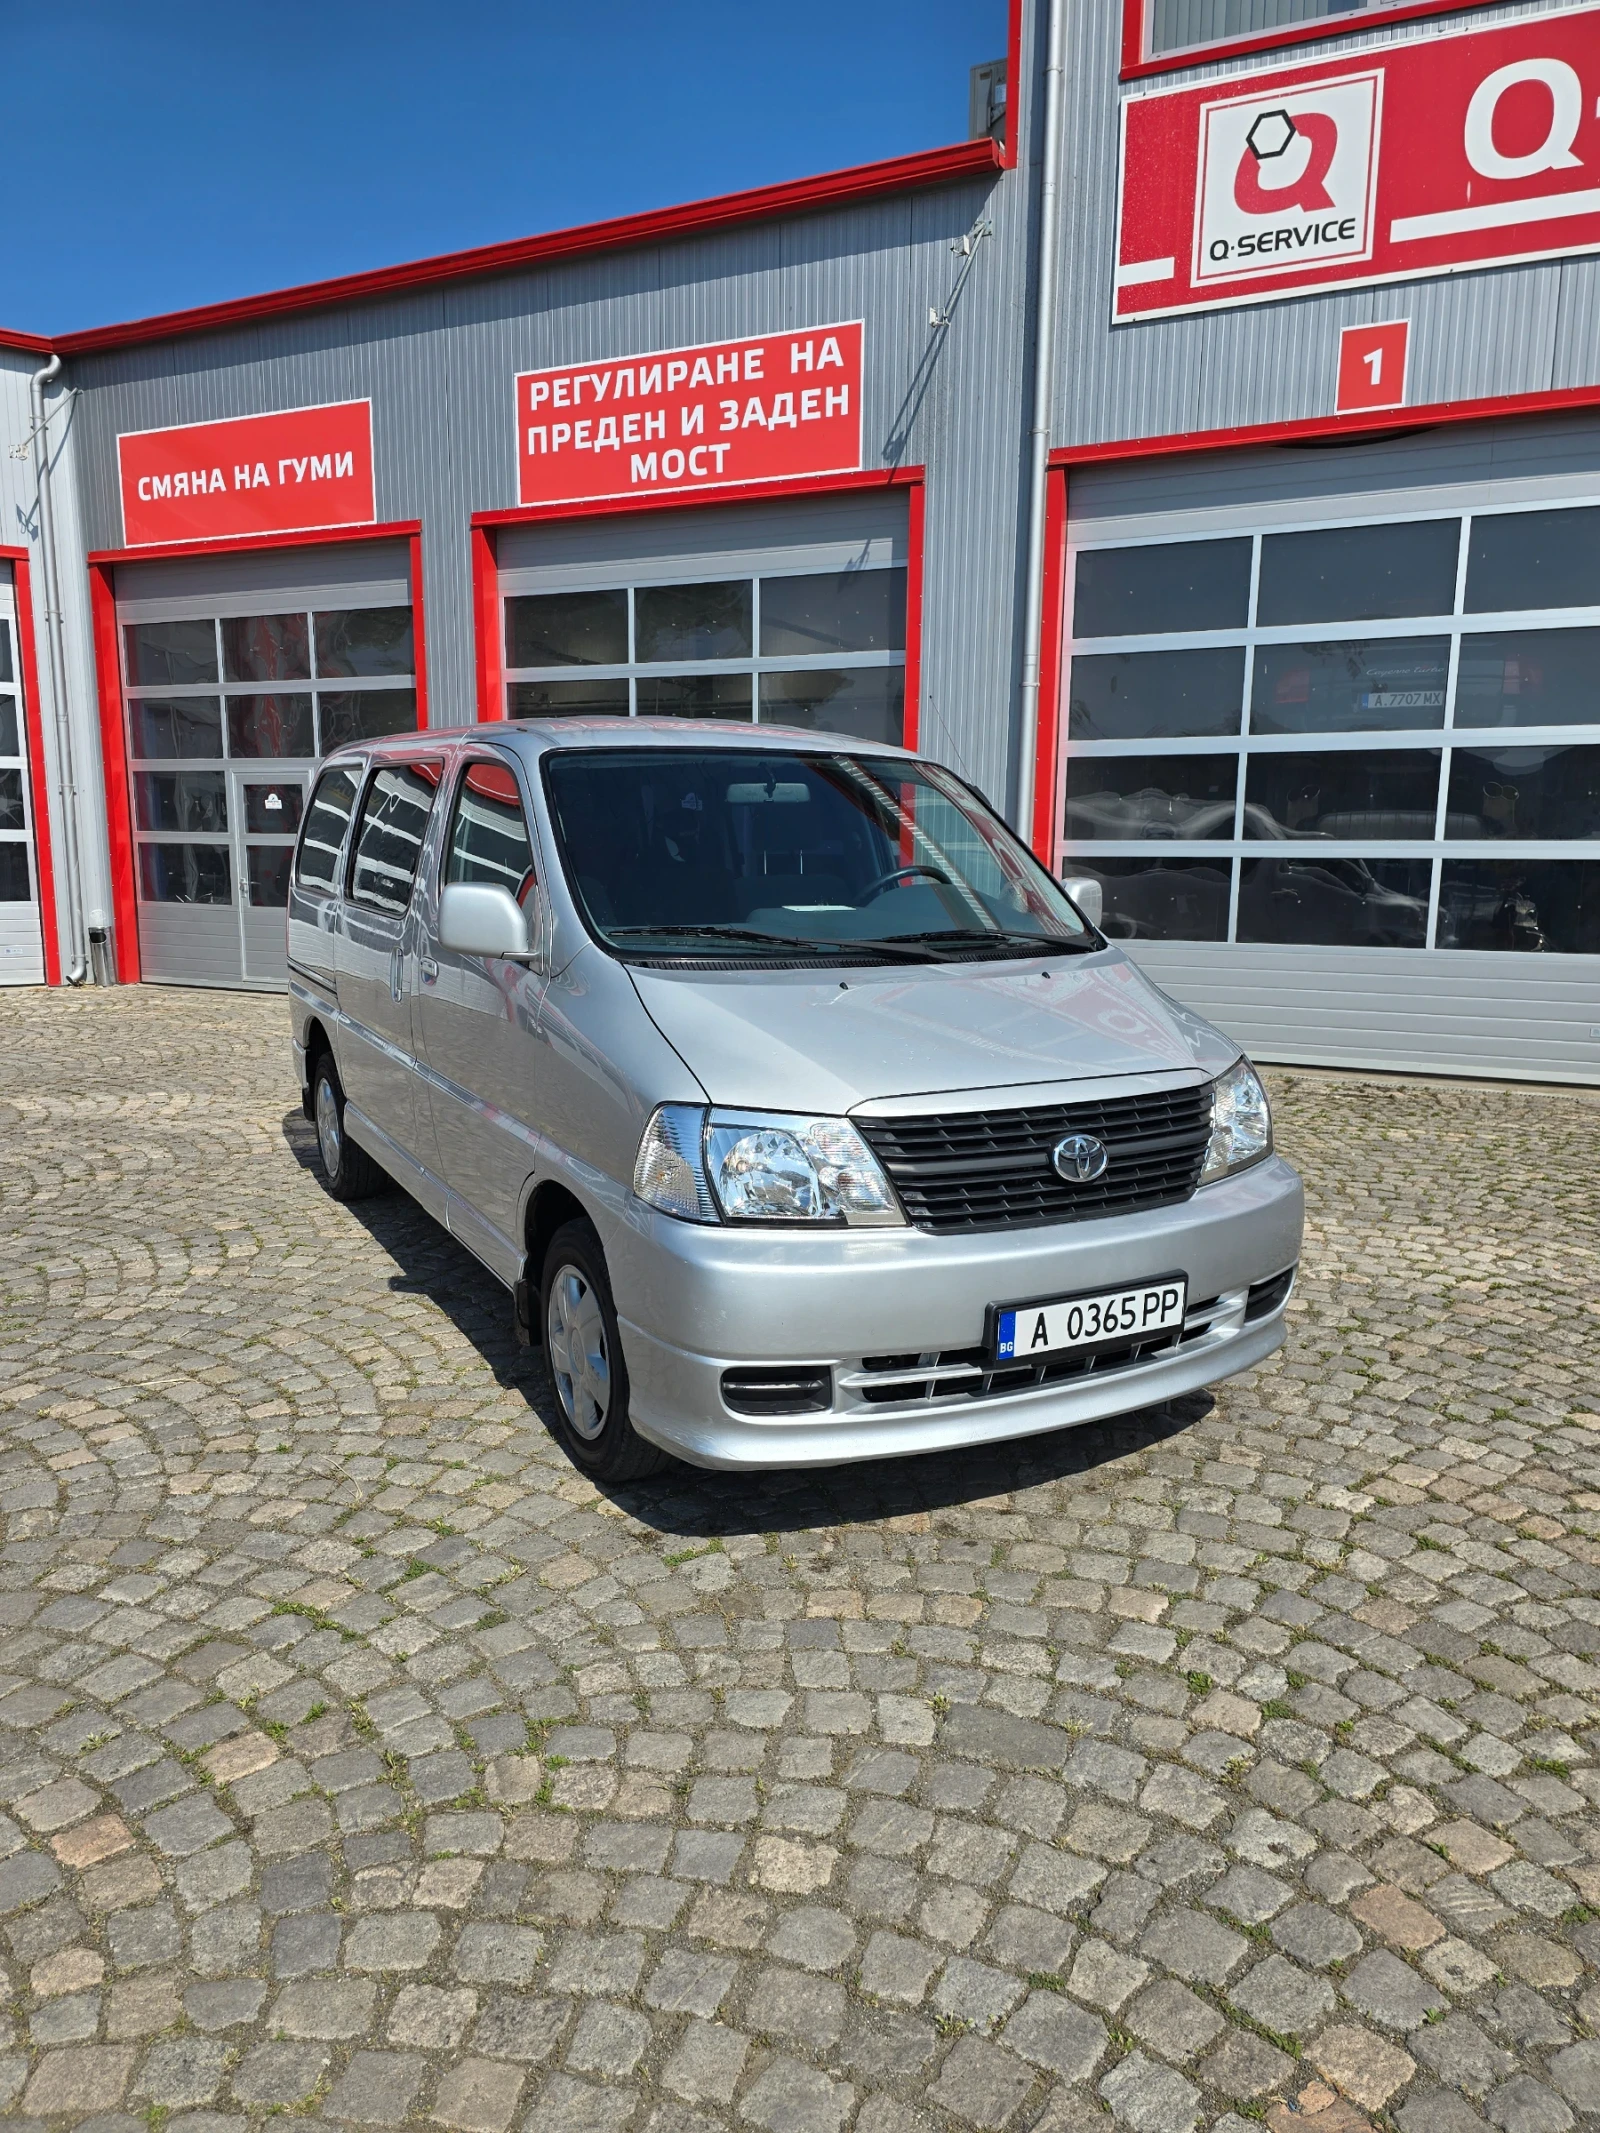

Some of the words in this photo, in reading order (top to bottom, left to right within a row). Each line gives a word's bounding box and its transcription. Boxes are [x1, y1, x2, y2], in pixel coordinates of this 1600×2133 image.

[1464, 57, 1600, 180] Q
[530, 347, 765, 411] РЕГУЛИРАНЕ
[790, 336, 844, 374] НА
[1362, 347, 1383, 386] 1
[527, 409, 666, 456] ПРЕДЕН
[681, 404, 704, 436] И
[718, 384, 849, 432] ЗАДЕН
[137, 468, 227, 501] СМЯНА
[234, 462, 271, 490] НА
[278, 450, 354, 485] ГУМИ
[630, 442, 731, 484] МОСТ
[999, 1341, 1013, 1354] BG
[1030, 1312, 1049, 1348] A
